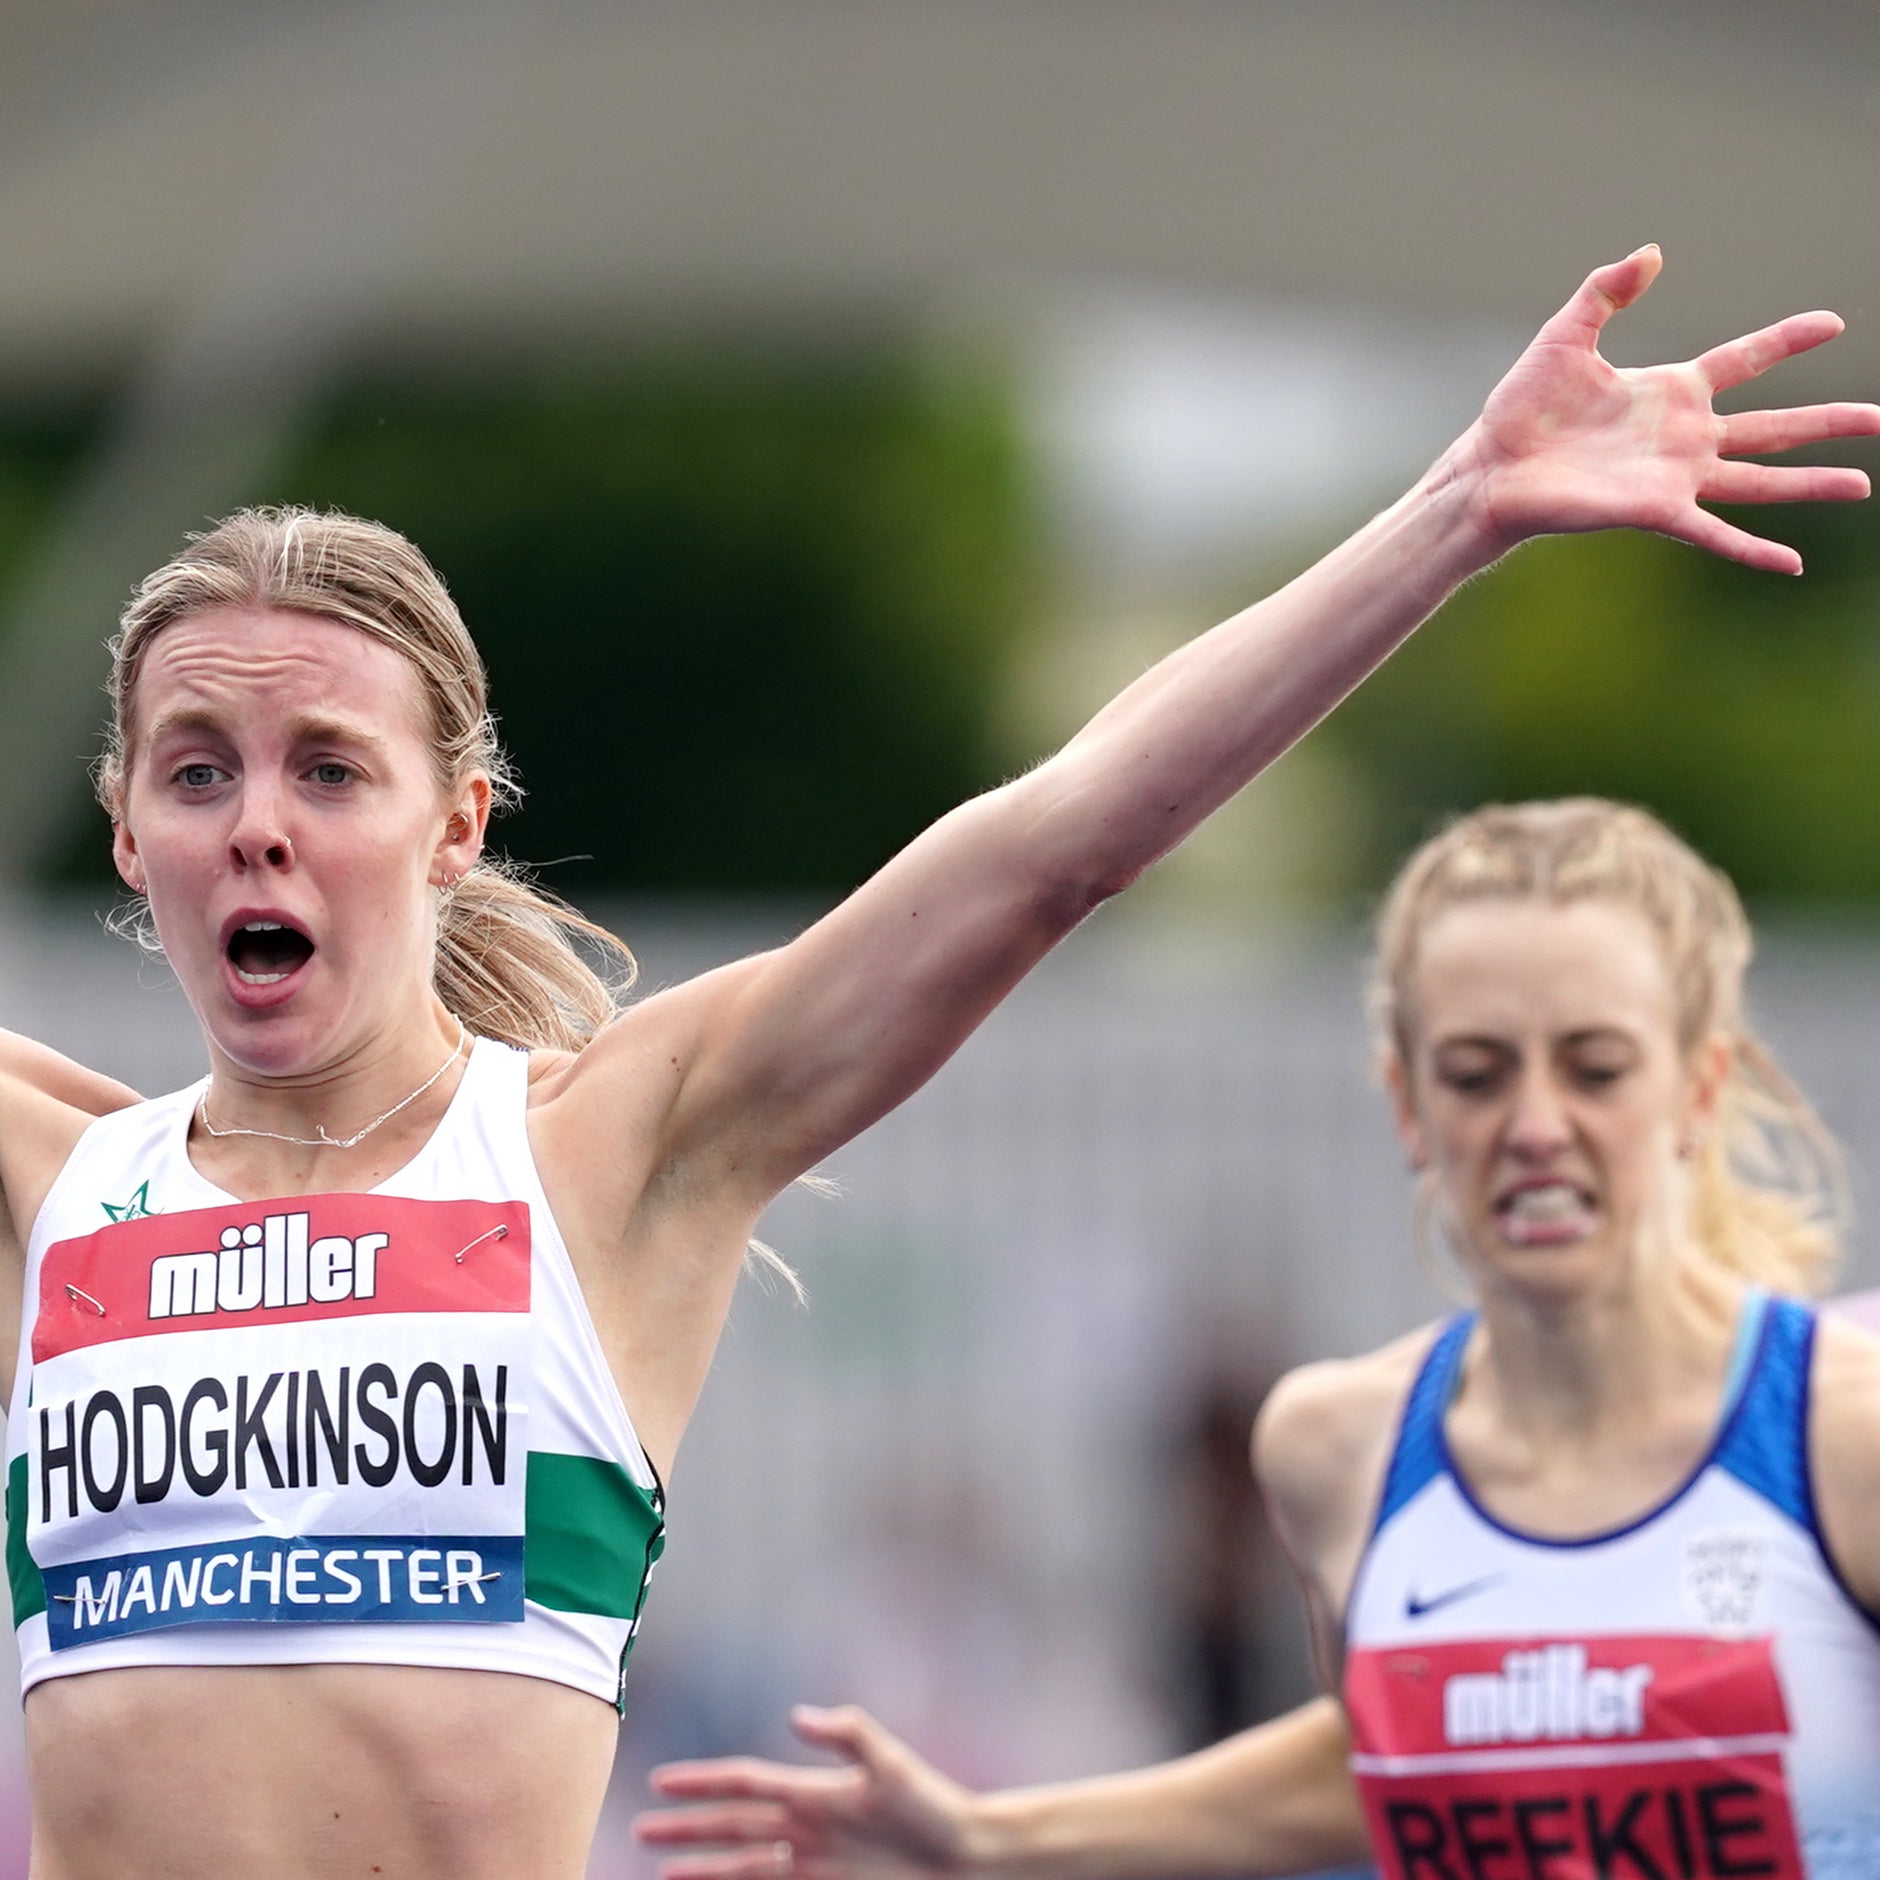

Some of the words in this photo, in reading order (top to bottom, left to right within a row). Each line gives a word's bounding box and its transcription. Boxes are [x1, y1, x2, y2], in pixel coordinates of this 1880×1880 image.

[149, 1211, 388, 1318] müller
[38, 1361, 508, 1524] HODGKINSON
[72, 1548, 486, 1630] MANCHESTER
[1446, 1646, 1651, 1743] müller
